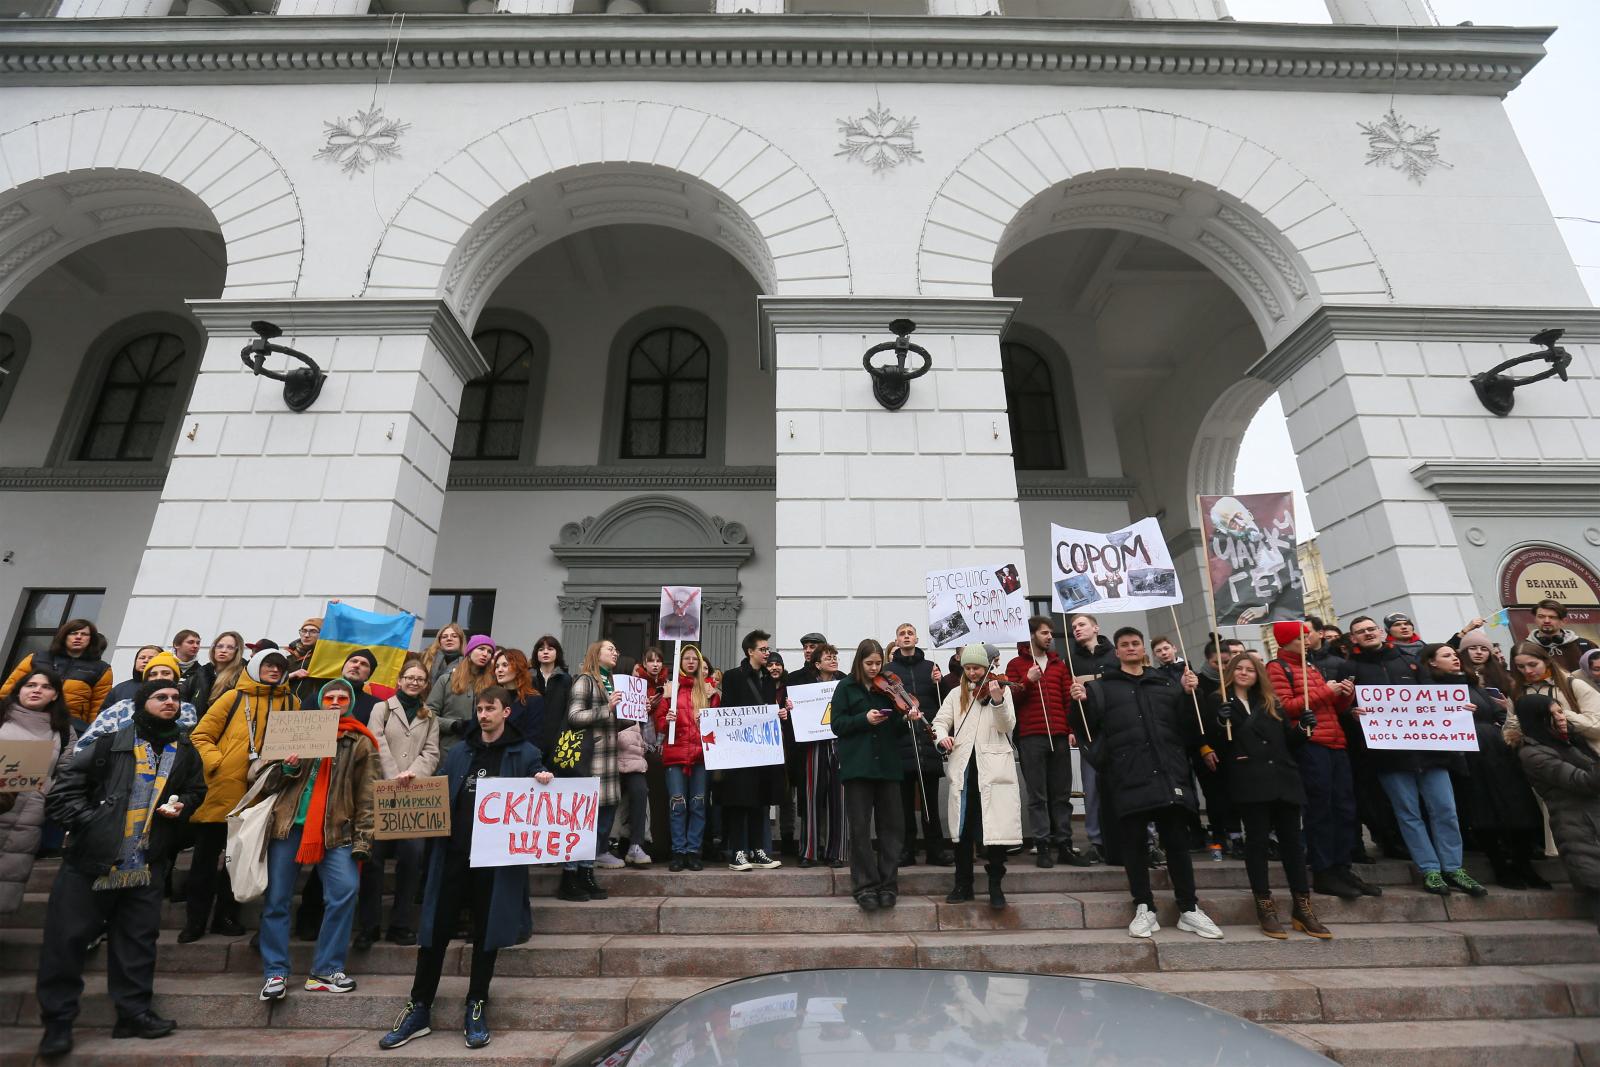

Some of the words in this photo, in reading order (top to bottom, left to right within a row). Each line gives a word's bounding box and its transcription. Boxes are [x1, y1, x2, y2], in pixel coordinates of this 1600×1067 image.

[1057, 534, 1151, 574] СОРОМ
[1229, 562, 1303, 603] ГЕТЬ
[1526, 577, 1578, 589] ВЕЛИКИЙ
[1544, 591, 1567, 600] ЗАЛ
[628, 676, 643, 693] NO
[1361, 688, 1466, 702] СОРОМНО
[702, 709, 709, 718] В
[1416, 706, 1437, 714] ВСЕ
[724, 718, 743, 727] БЕЗ
[1369, 719, 1452, 727] МУСИМО
[1369, 733, 1398, 741] ЩОСЬ
[1403, 732, 1476, 741] ДОВОДИТИ
[379, 811, 446, 832] ЗВІДУСІЛЬ!
[508, 830, 581, 861] ЩЕ?
